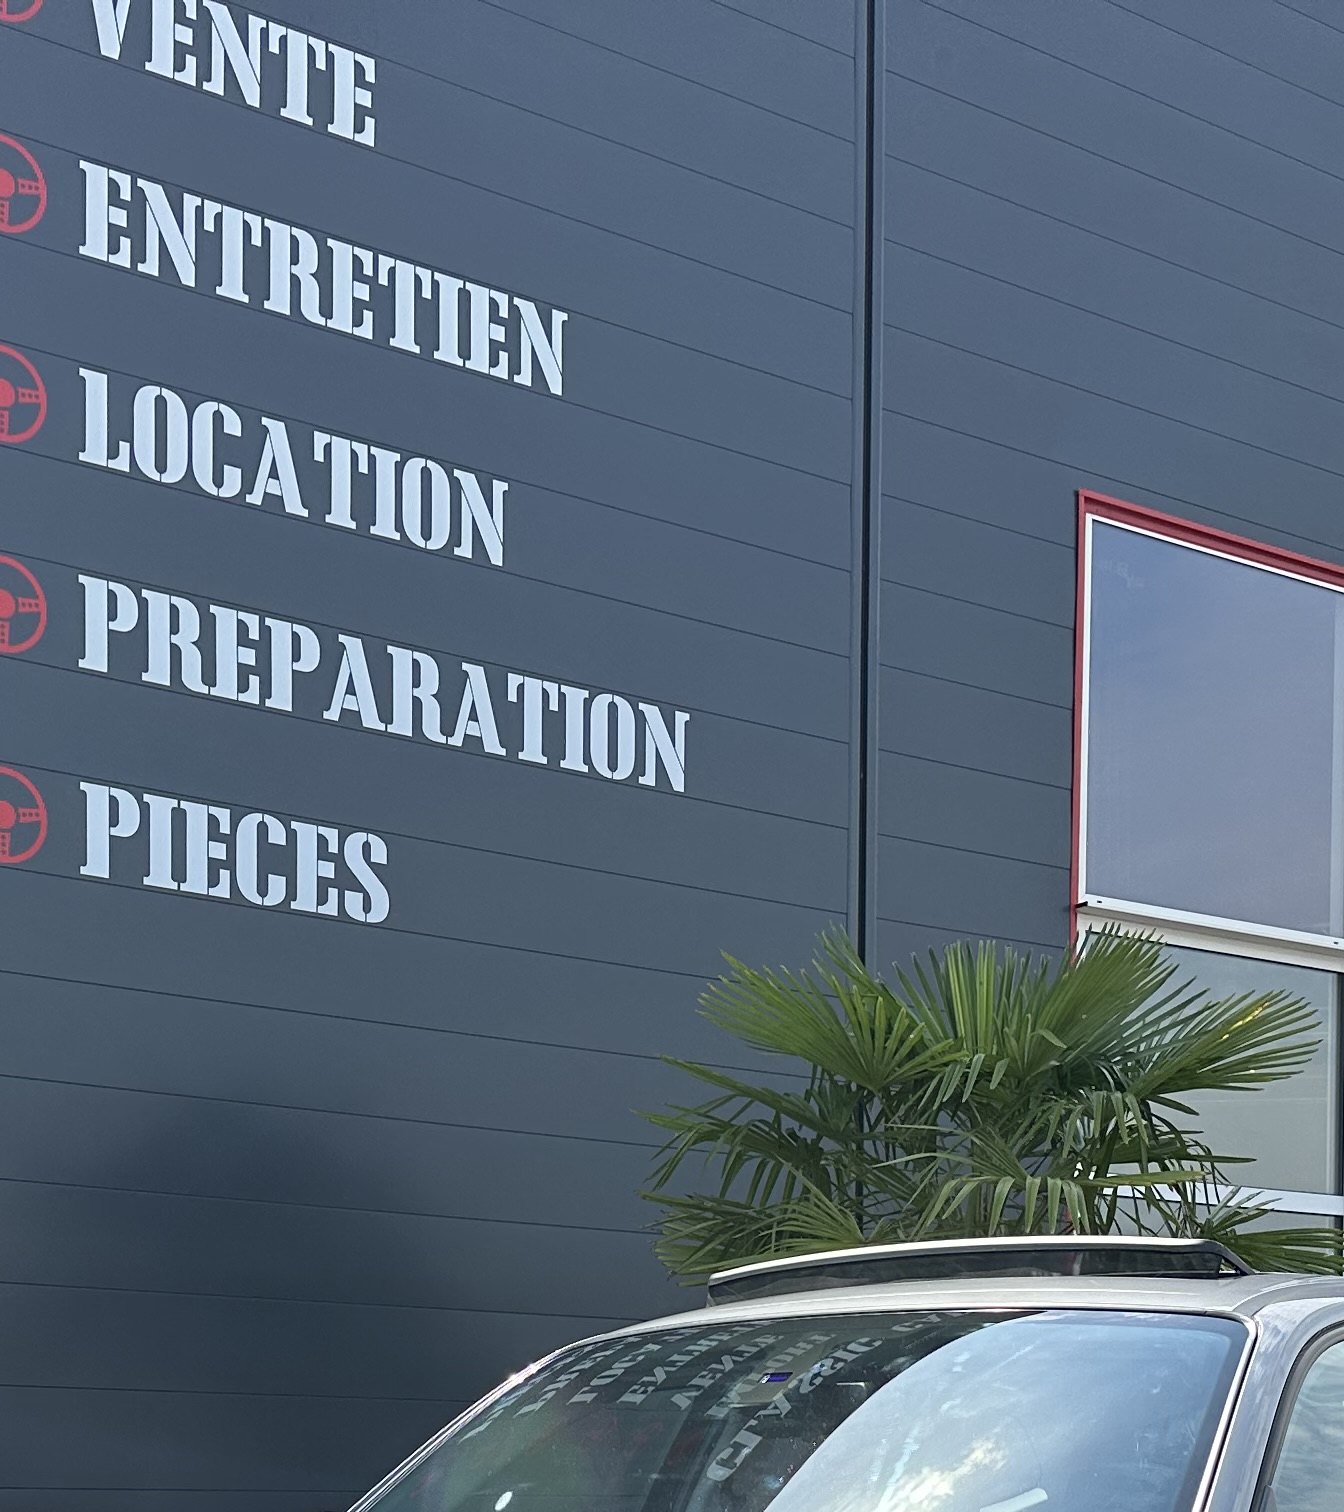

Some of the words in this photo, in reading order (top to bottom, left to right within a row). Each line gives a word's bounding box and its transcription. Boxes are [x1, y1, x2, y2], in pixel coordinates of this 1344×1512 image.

[92, 0, 376, 147] VENTE
[78, 159, 569, 396] ENTRETIEN
[78, 366, 509, 567] LOCATION
[78, 573, 690, 793] PREPARATION
[78, 780, 391, 924] PIECES
